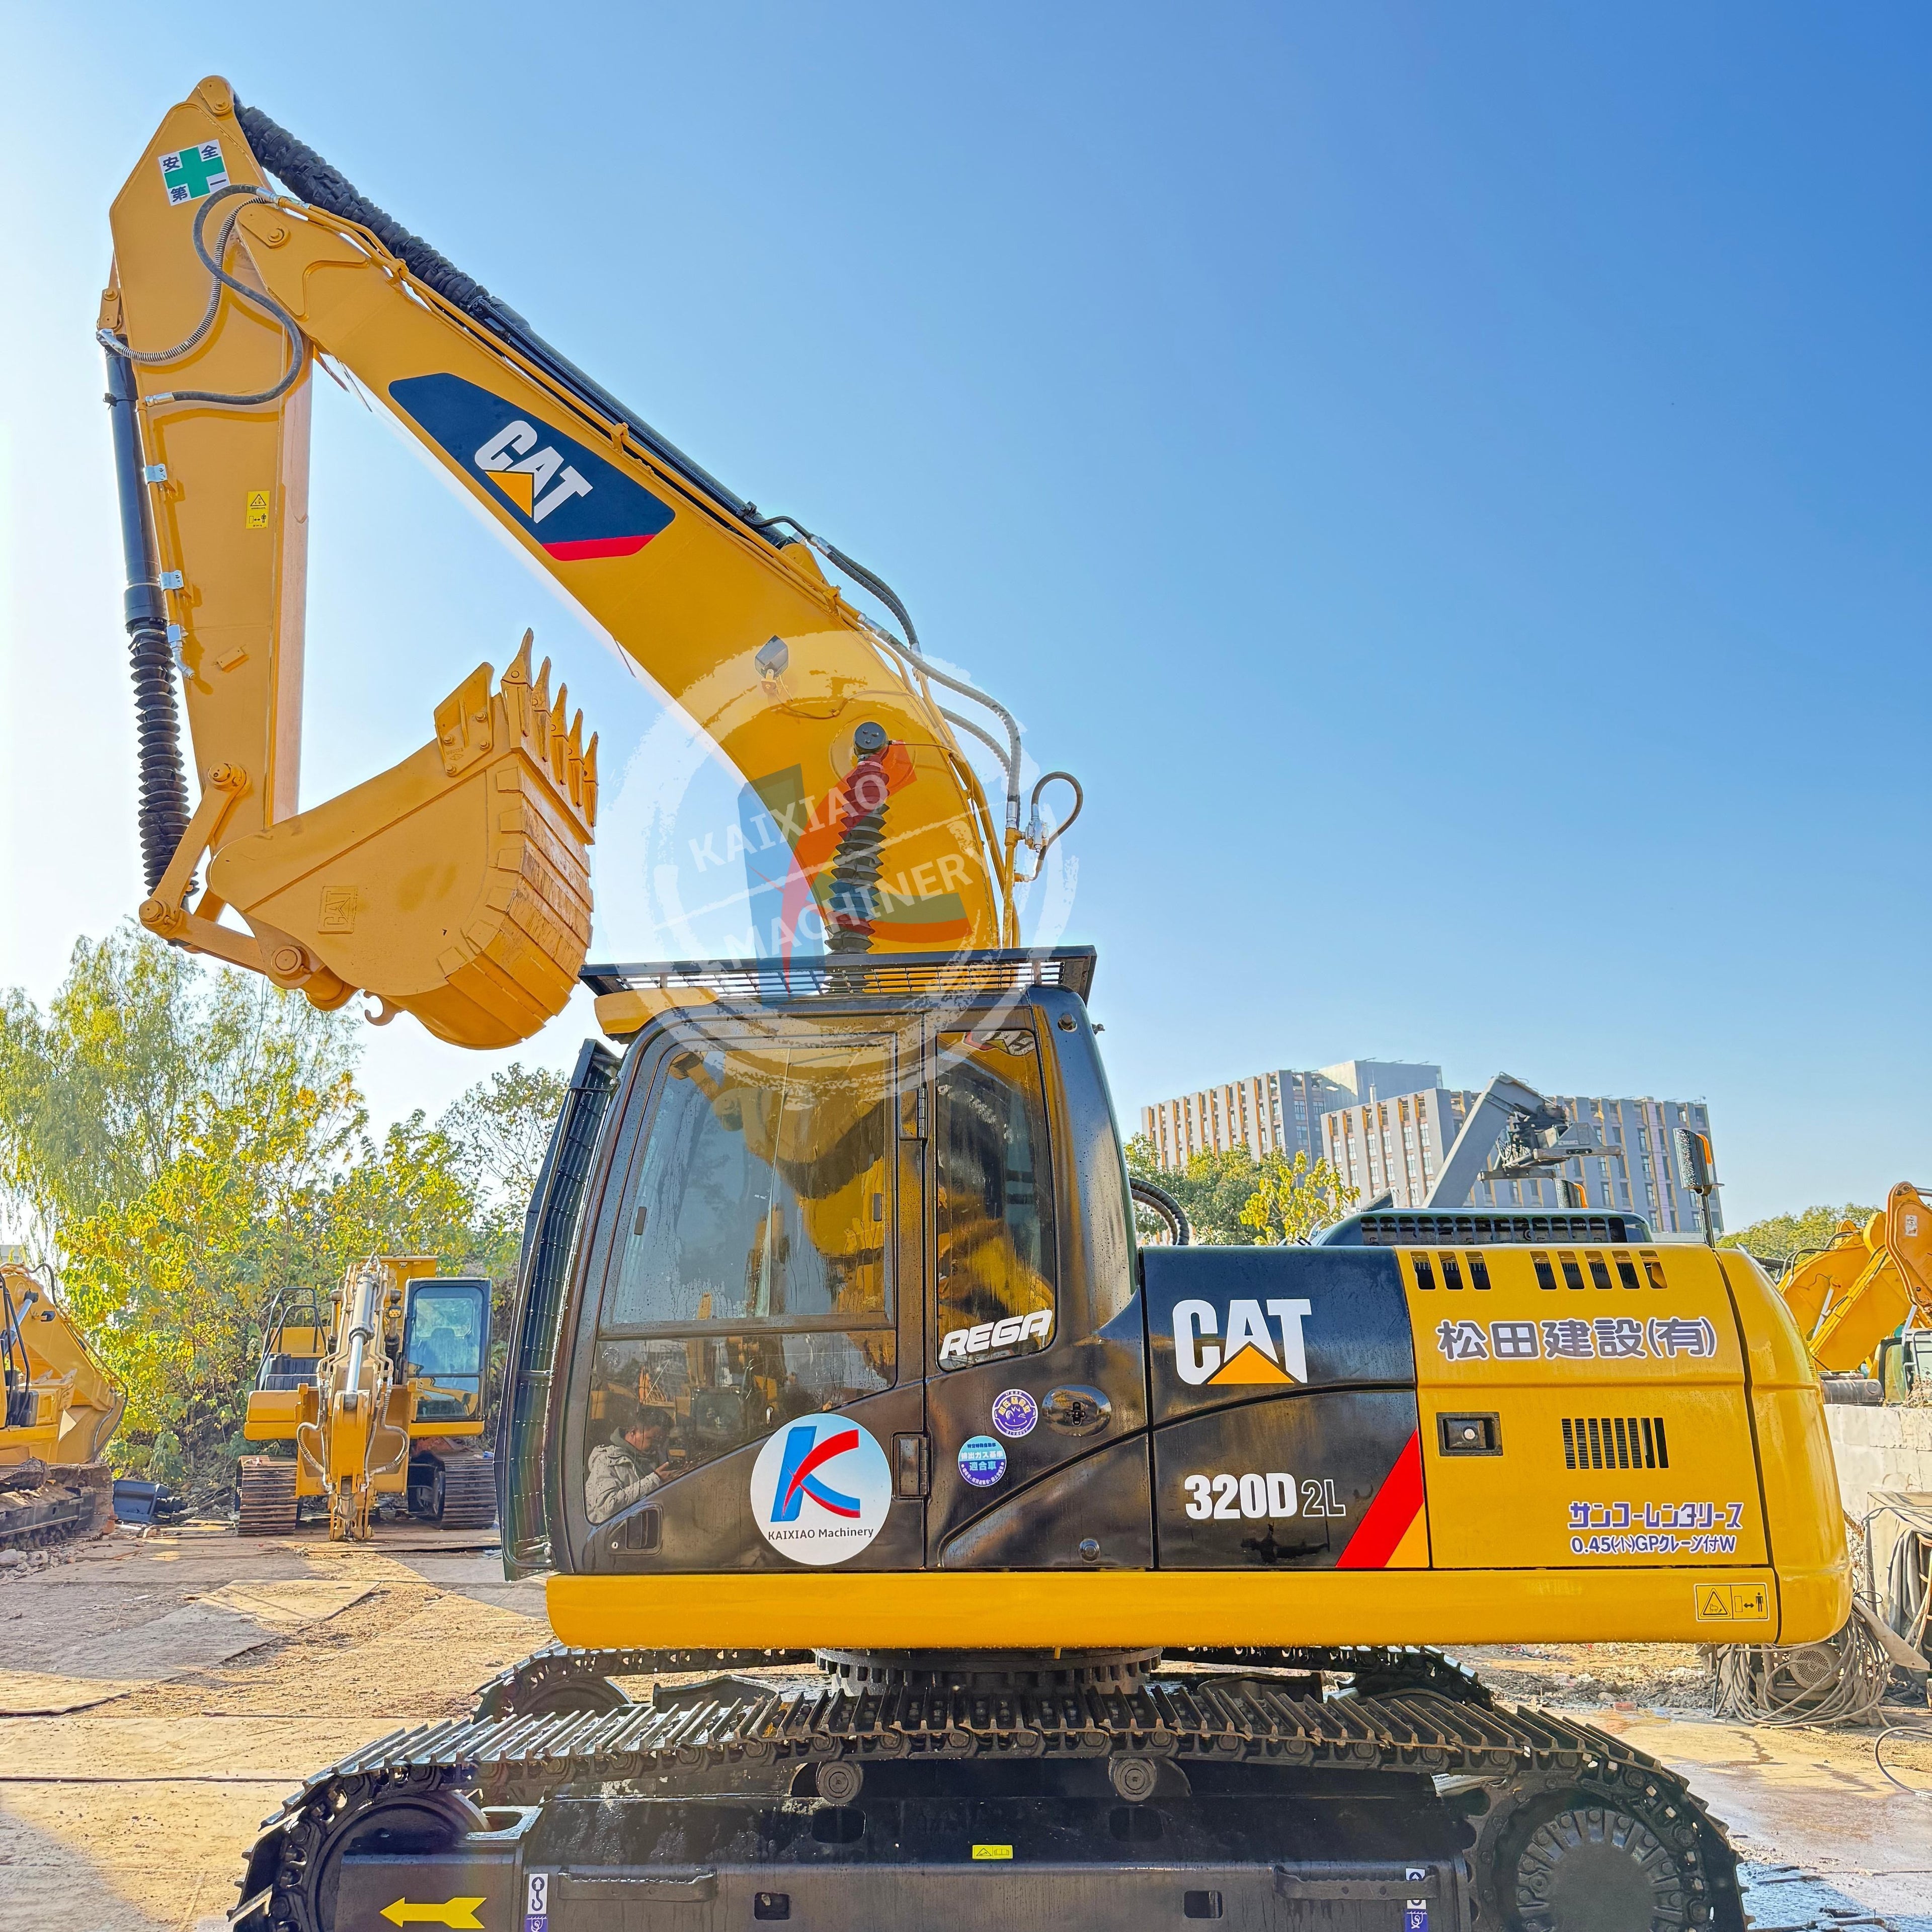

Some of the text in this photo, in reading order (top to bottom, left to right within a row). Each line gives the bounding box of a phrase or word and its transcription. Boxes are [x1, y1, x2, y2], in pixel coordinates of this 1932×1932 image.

[474, 420, 593, 523] CAT
[939, 1309, 1053, 1360] REGA
[1172, 1299, 1312, 1385] CAT
[1436, 1318, 1715, 1359] 松田建設(有)
[1184, 1473, 1346, 1520] 320D 2L
[1568, 1501, 1744, 1529] サンコーレンタリース
[768, 1527, 874, 1540] KAIXIAO Machinery
